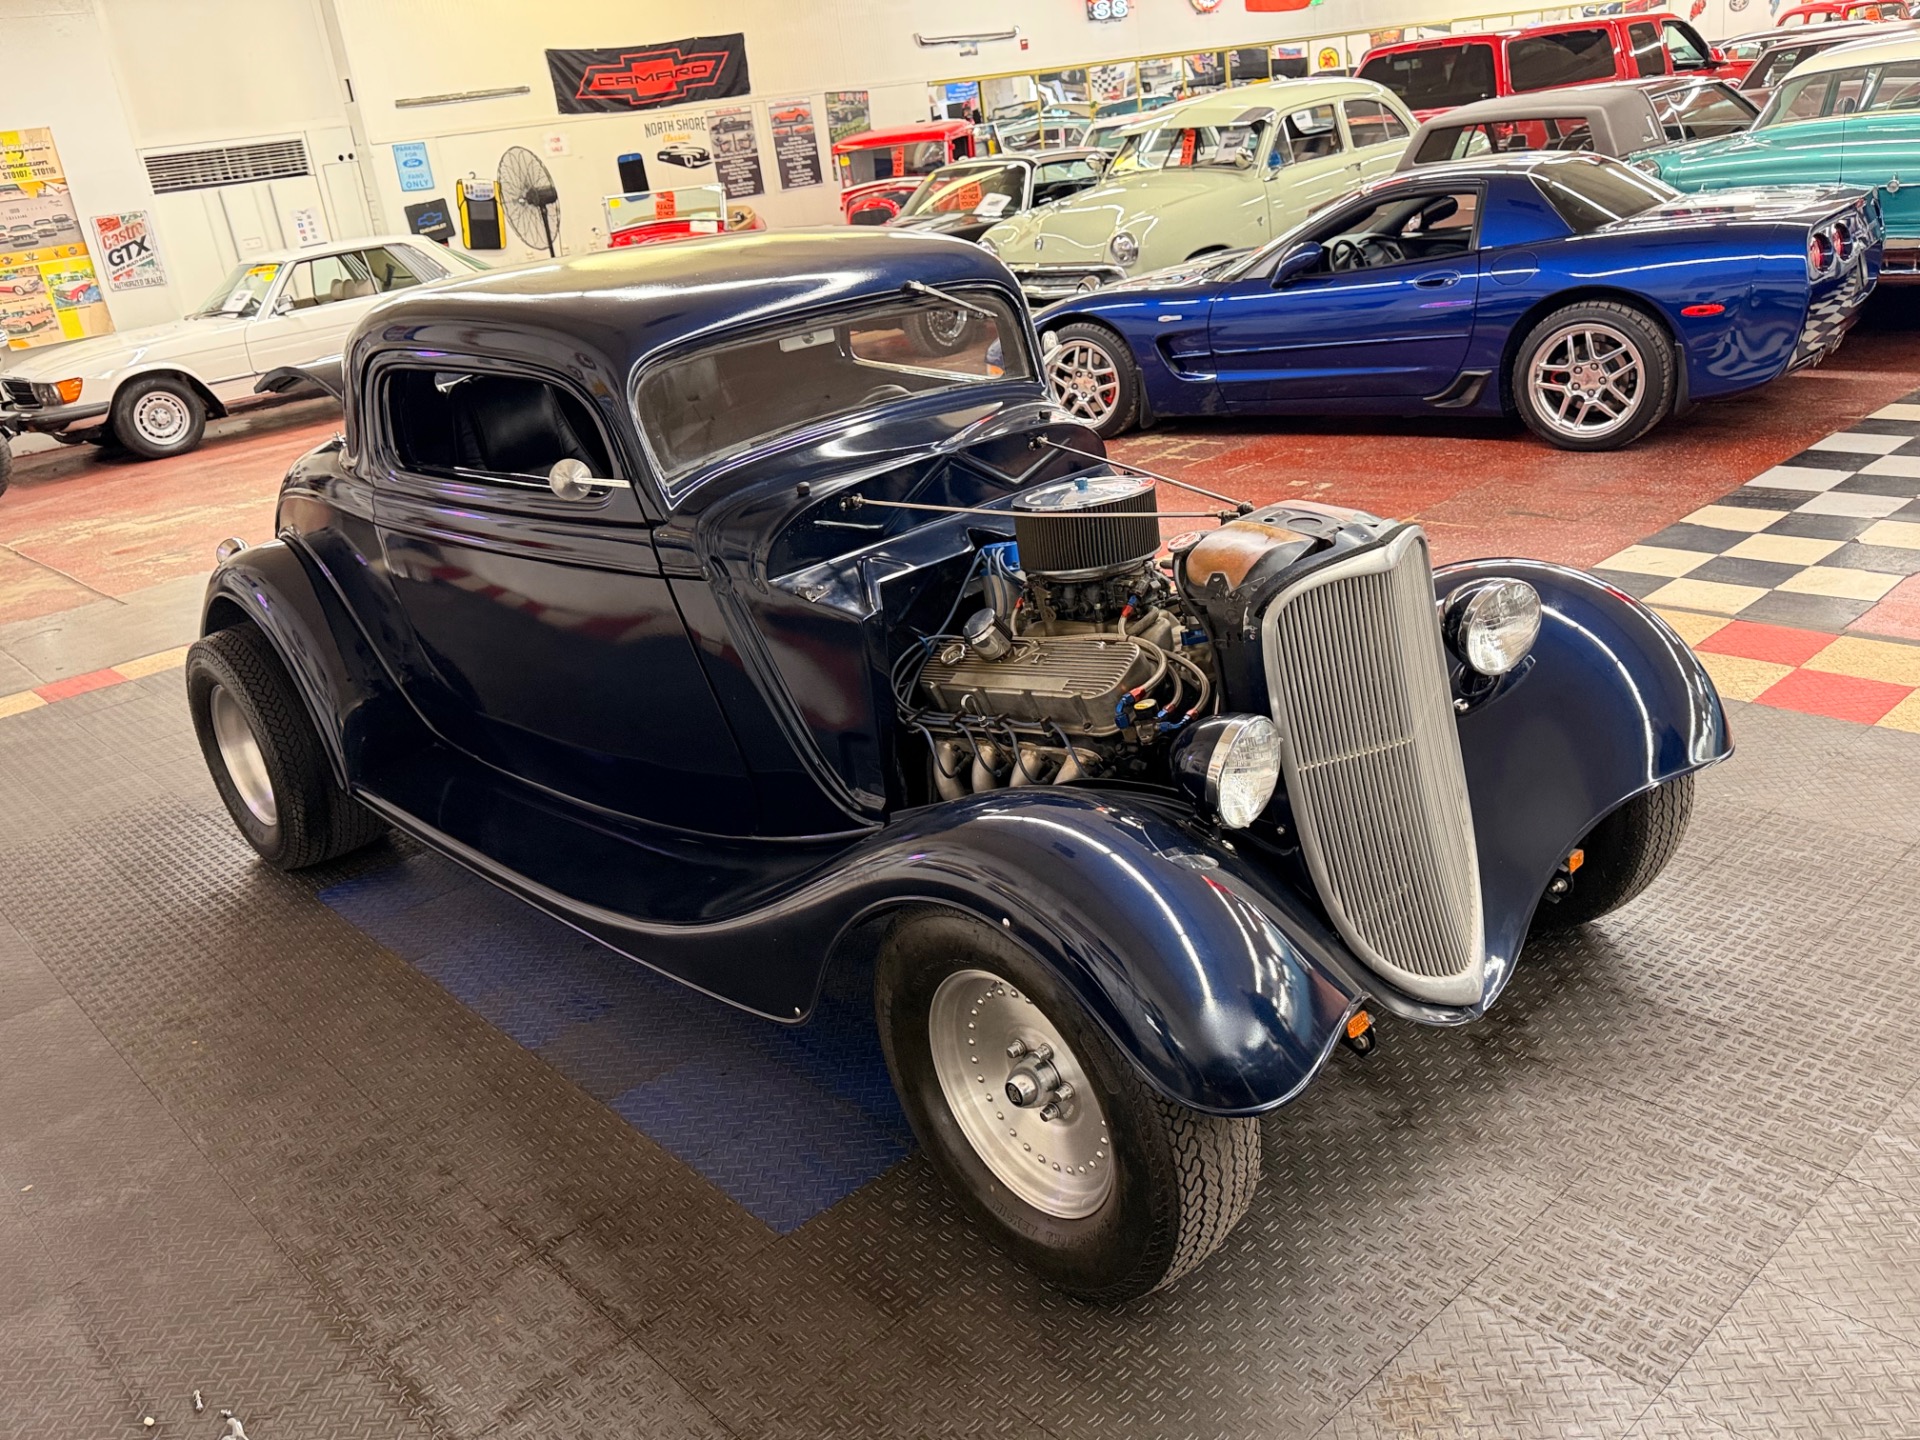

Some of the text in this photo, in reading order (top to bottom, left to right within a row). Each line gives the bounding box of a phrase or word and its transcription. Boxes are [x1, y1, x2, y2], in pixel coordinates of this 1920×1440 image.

[598, 64, 708, 86] CAMARO
[644, 116, 706, 138] NORTH SHORE
[405, 179, 429, 189] ONLY
[108, 235, 151, 267] GTX
